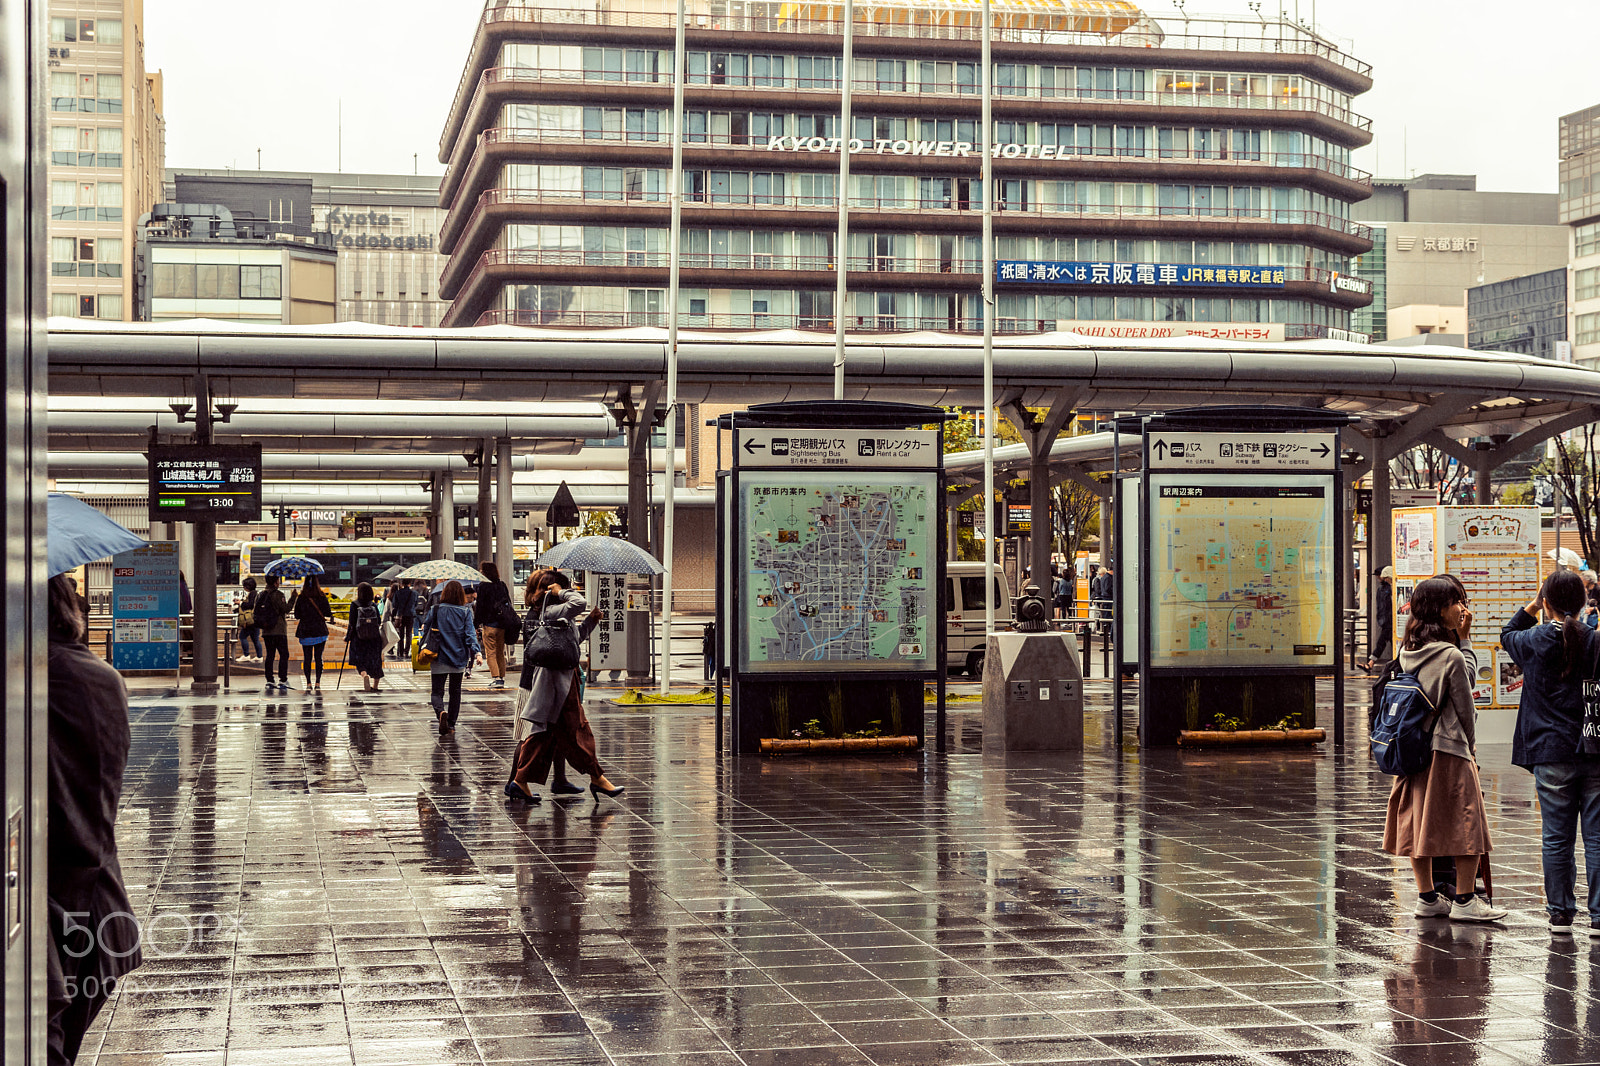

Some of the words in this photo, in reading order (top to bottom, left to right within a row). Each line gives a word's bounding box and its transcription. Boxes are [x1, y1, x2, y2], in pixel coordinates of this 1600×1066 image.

[766, 135, 864, 153] KYOTO
[874, 138, 972, 158] TOWER
[981, 142, 1072, 161] HOTEL
[1423, 237, 1479, 252] 京都銀行
[1090, 263, 1179, 285] 京阪電車
[1181, 268, 1285, 285] JR東福寺駅と直結
[1336, 277, 1366, 294] KEIHAN
[1108, 327, 1147, 338] SUPER
[1150, 327, 1176, 338] DRY
[790, 438, 846, 450] 定期観光バス
[876, 439, 930, 450] 駅レンタカー
[1185, 442, 1202, 452] バス
[1235, 442, 1261, 452] 地下鉄
[1277, 442, 1308, 452] タクシー
[790, 450, 829, 458] Sightseeing
[231, 467, 253, 475] JRバス
[753, 487, 807, 496] 京都市内案内
[208, 498, 234, 507] 13:00
[613, 577, 625, 632] 梅小路公園
[599, 577, 610, 654] 京都鉄道博物館
